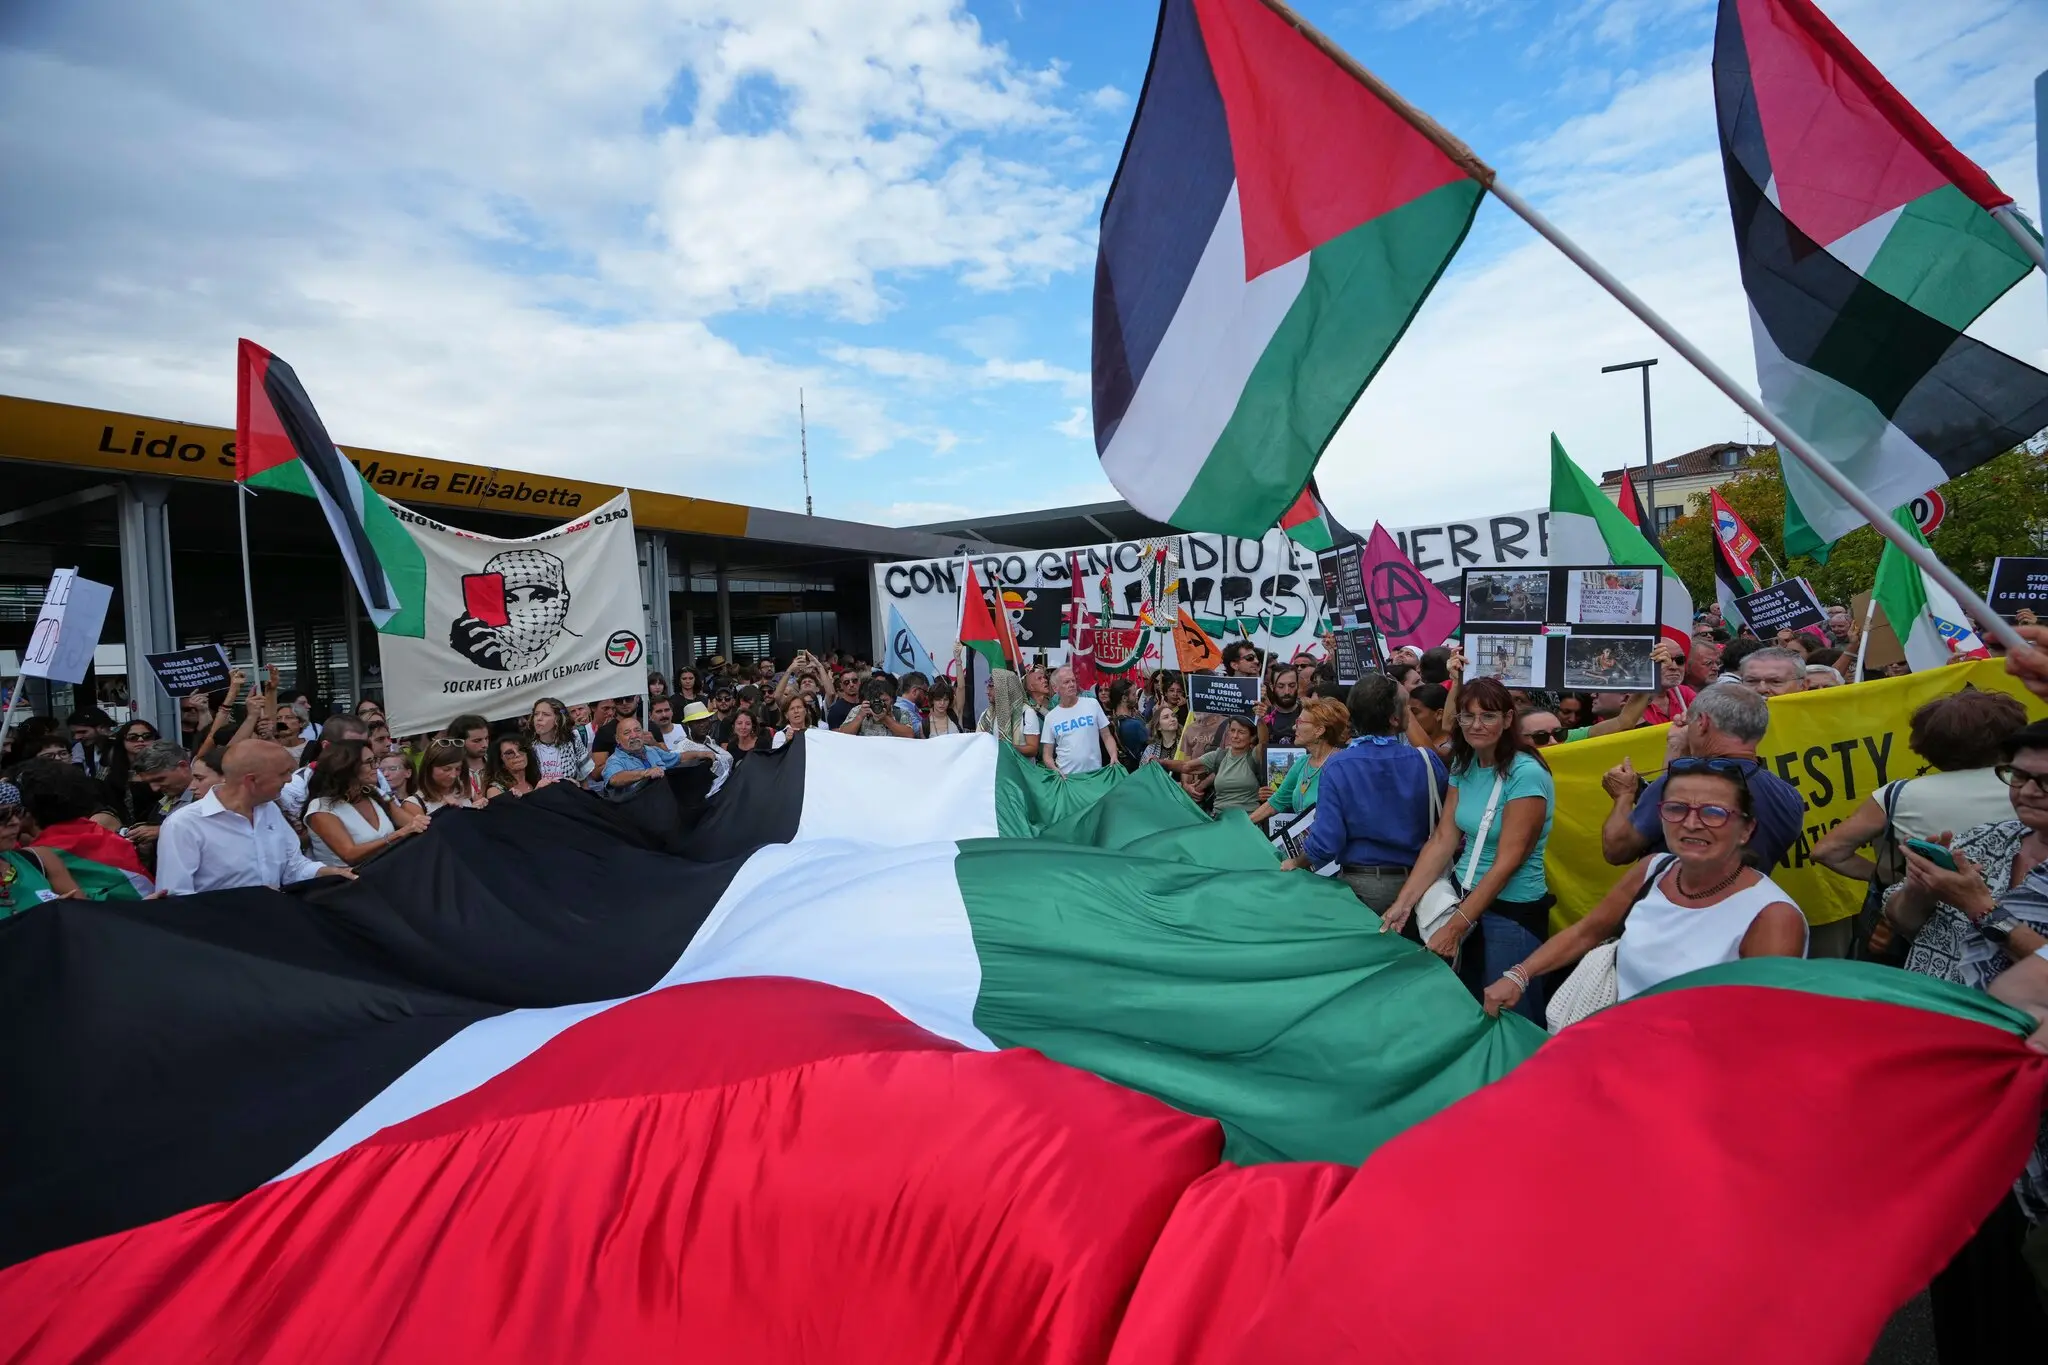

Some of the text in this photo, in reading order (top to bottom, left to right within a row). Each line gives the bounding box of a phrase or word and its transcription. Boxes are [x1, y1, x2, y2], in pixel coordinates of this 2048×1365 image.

[98, 426, 205, 462] Lido
[351, 459, 439, 491] Maria
[447, 472, 583, 508] Elisabetta
[594, 508, 628, 525] CARD
[1909, 497, 1929, 524] 0
[1036, 535, 1264, 582] GENOIDIO
[2026, 574, 2048, 582] STO
[2027, 583, 2048, 591] THE
[1748, 590, 1785, 607] ISRAEL IS
[1999, 592, 2048, 600] GENOC
[1751, 599, 1782, 614] MAKING
[1751, 600, 1800, 622] MOCKERY OF
[1751, 605, 1814, 629] INTERNATIONAL
[1774, 620, 1792, 630] LAW
[1094, 631, 1124, 647] FREE
[158, 661, 220, 675] PERPETRATING
[163, 656, 204, 668] ISRAEL IS
[177, 674, 225, 688] PALESTINE
[180, 671, 210, 681] SHOAH
[443, 677, 502, 694] SOCRATES
[506, 668, 550, 688] AGAINST
[1211, 681, 1239, 690] ISRAEL
[1194, 692, 1243, 704] STARVATION
[1217, 689, 1242, 698] USING
[1205, 705, 1245, 713] SOLUTION
[1054, 715, 1094, 736] PEACE
[1764, 732, 1893, 812] ESTY
